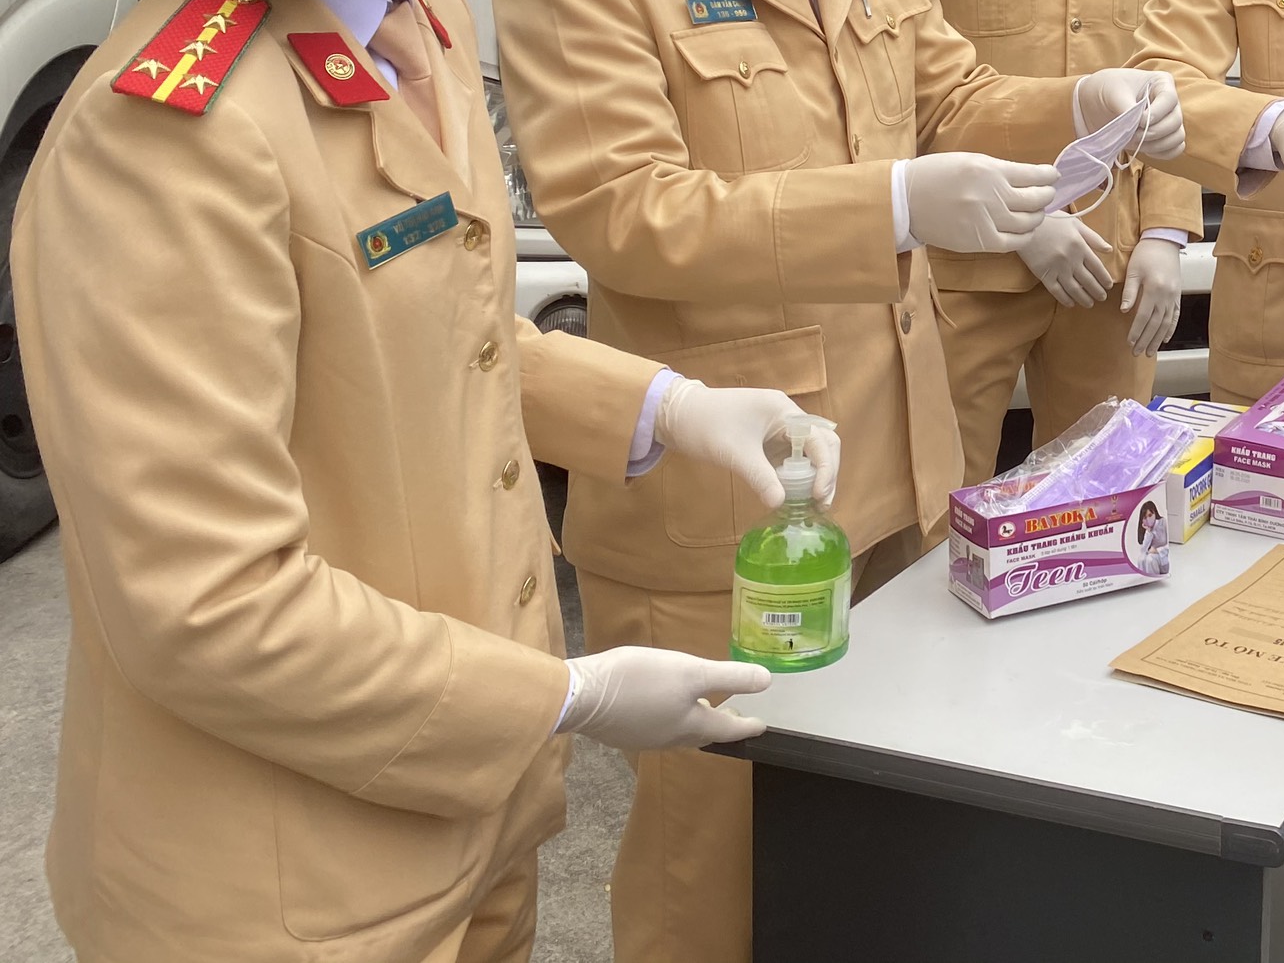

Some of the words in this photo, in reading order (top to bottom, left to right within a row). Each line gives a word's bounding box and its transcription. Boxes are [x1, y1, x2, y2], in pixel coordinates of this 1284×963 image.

[1252, 450, 1276, 461] TRANG
[1233, 456, 1251, 465] FACE
[1252, 460, 1271, 469] MASK
[1025, 507, 1098, 534] BAYOKA
[1031, 539, 1058, 551] TRANG
[1060, 531, 1086, 545] KHÁNG
[1005, 562, 1087, 597] Teen
[1204, 637, 1230, 649] TÔ
[1233, 645, 1267, 658] MÔ
